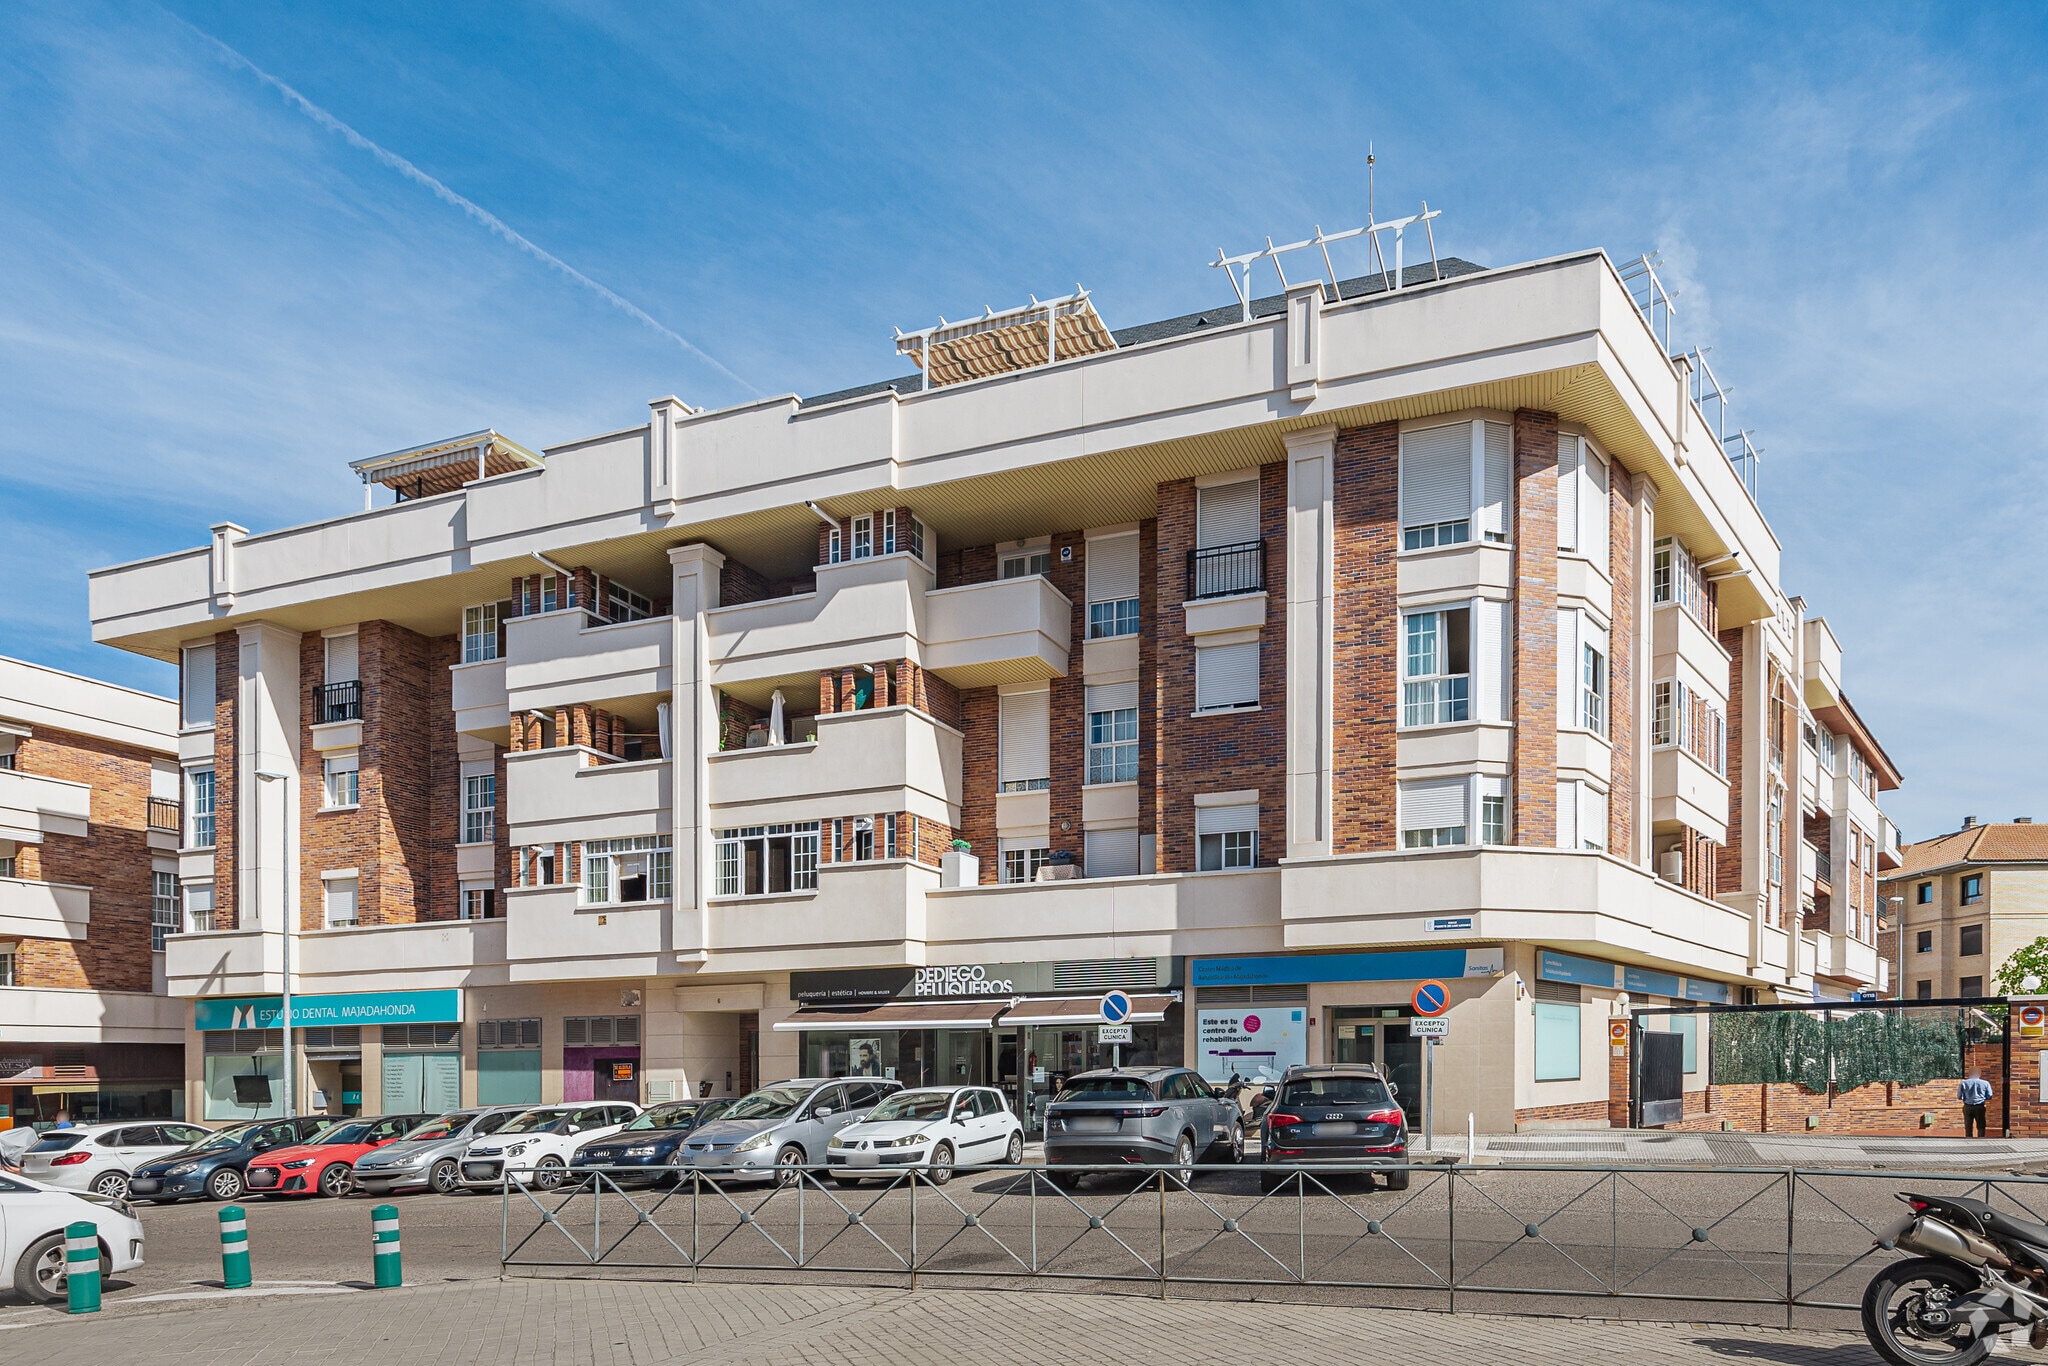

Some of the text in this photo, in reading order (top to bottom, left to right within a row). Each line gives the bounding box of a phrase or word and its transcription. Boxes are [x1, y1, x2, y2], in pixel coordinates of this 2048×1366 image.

[915, 965, 985, 983] DEDIEGO
[915, 979, 1013, 996] PELUQUEROS
[260, 1004, 416, 1021] ESTUO DENTAL MAJADAHONDA
